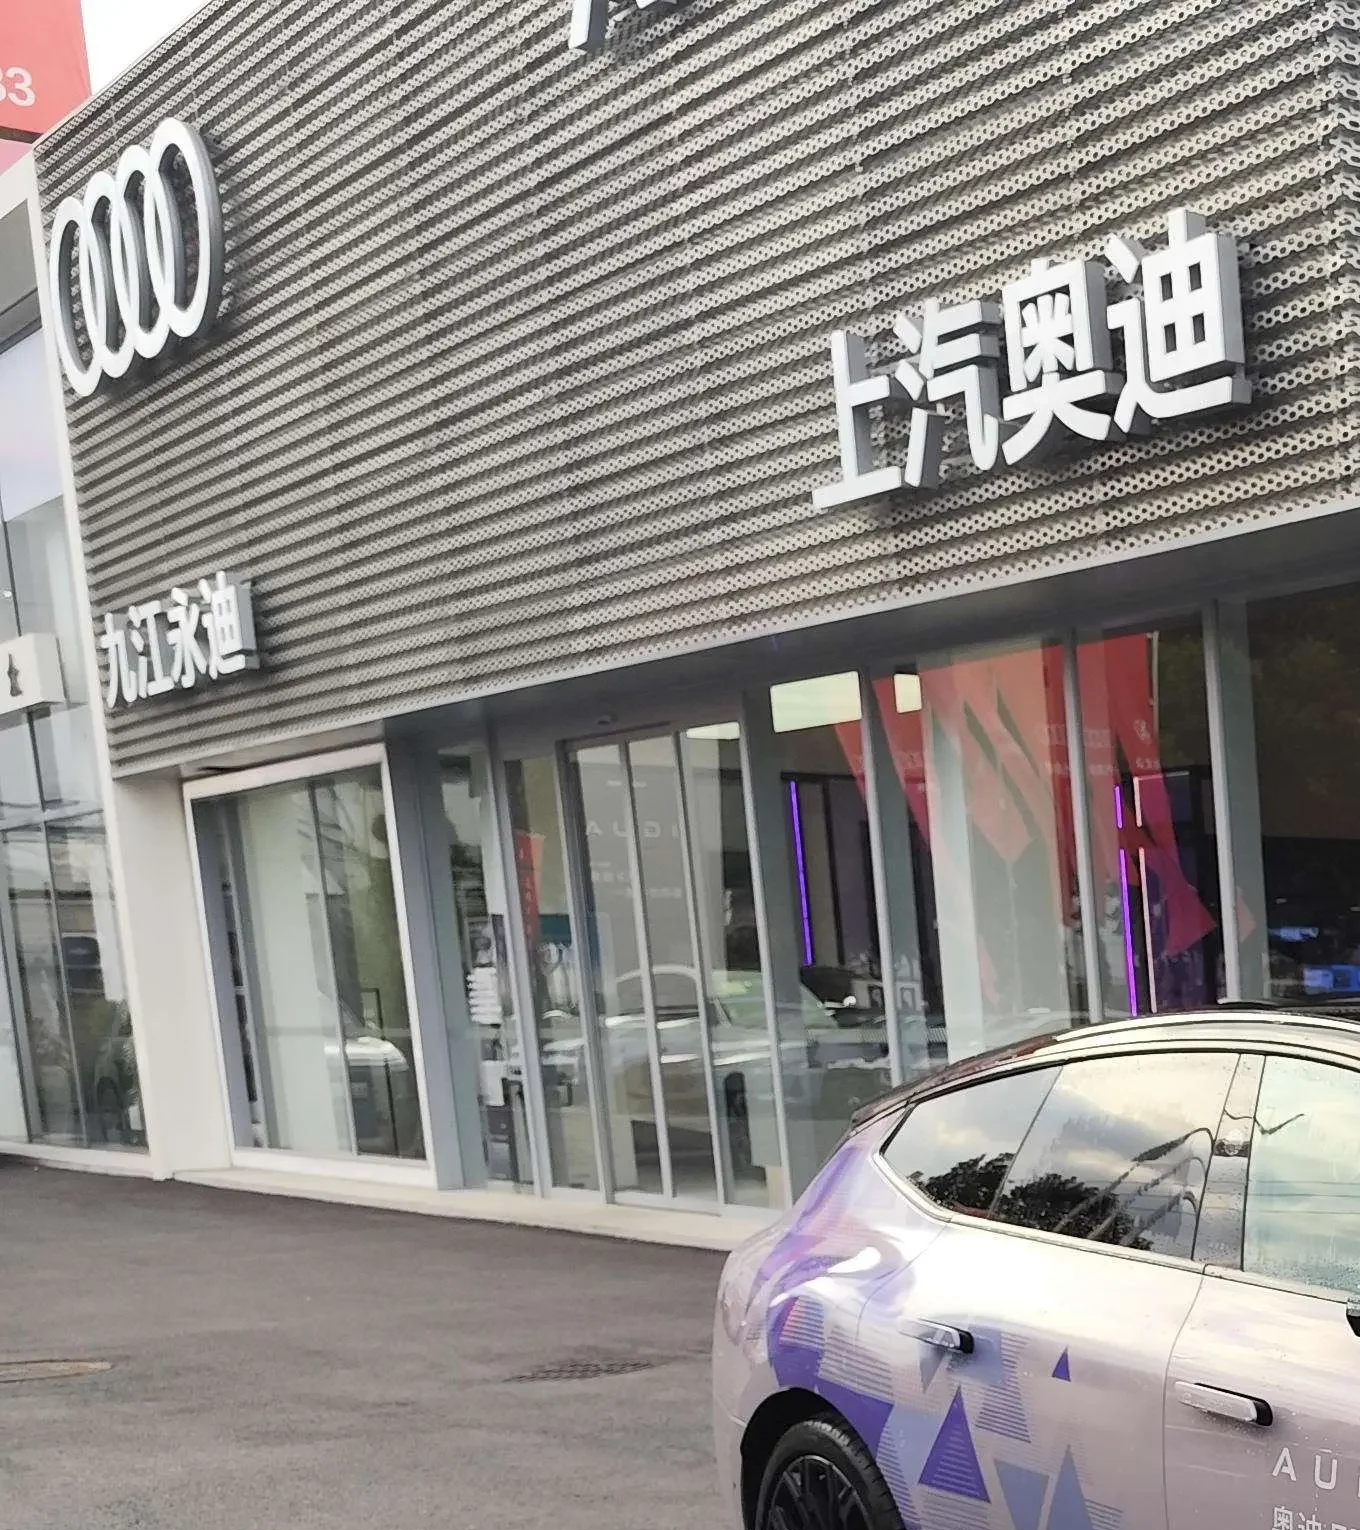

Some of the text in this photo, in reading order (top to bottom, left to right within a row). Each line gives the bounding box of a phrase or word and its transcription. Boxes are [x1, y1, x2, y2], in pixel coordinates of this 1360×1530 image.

[0, 67, 36, 108] 3
[812, 208, 1240, 509] 上汽奥迪
[101, 578, 248, 709] 九江永迪
